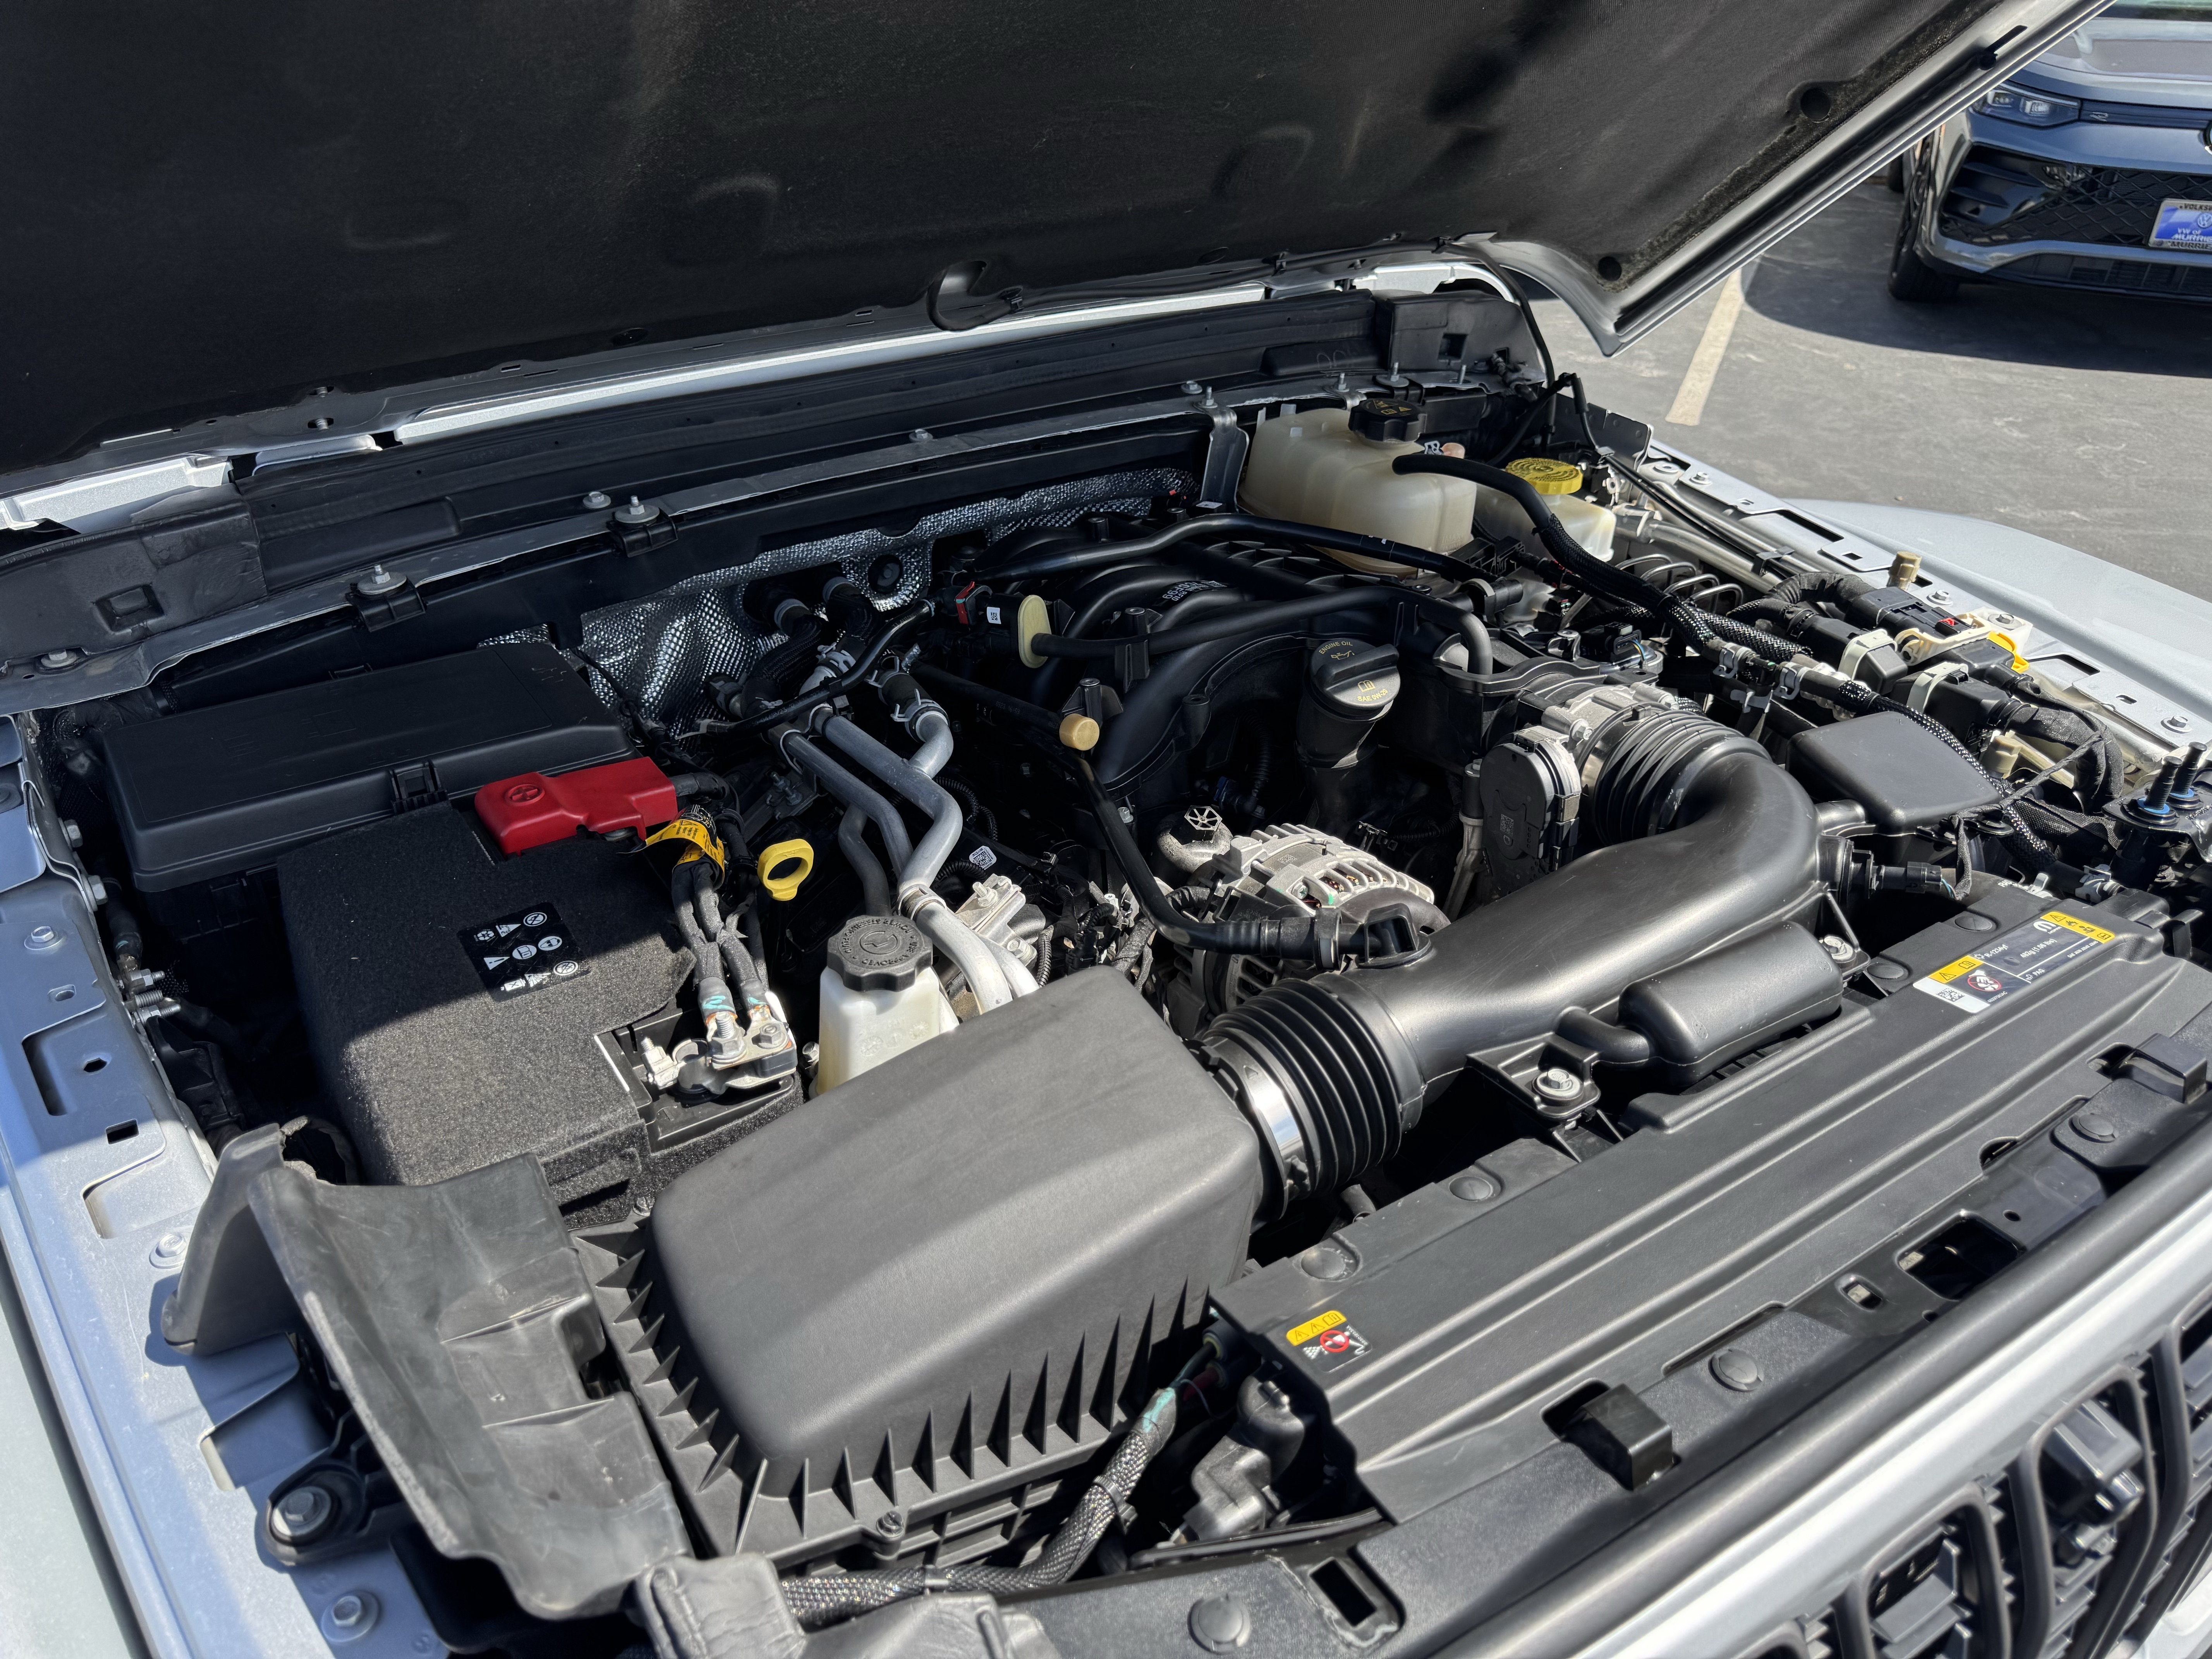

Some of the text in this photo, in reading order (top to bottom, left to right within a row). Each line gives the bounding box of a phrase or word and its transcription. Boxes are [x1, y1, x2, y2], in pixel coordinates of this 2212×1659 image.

[1319, 642, 1340, 654] ENGINE
[1372, 689, 1388, 700] 0W-20
[1984, 944, 2009, 958] R-1234yf
[2020, 950, 2036, 958] 482g
[2031, 943, 2047, 953] (1.06
